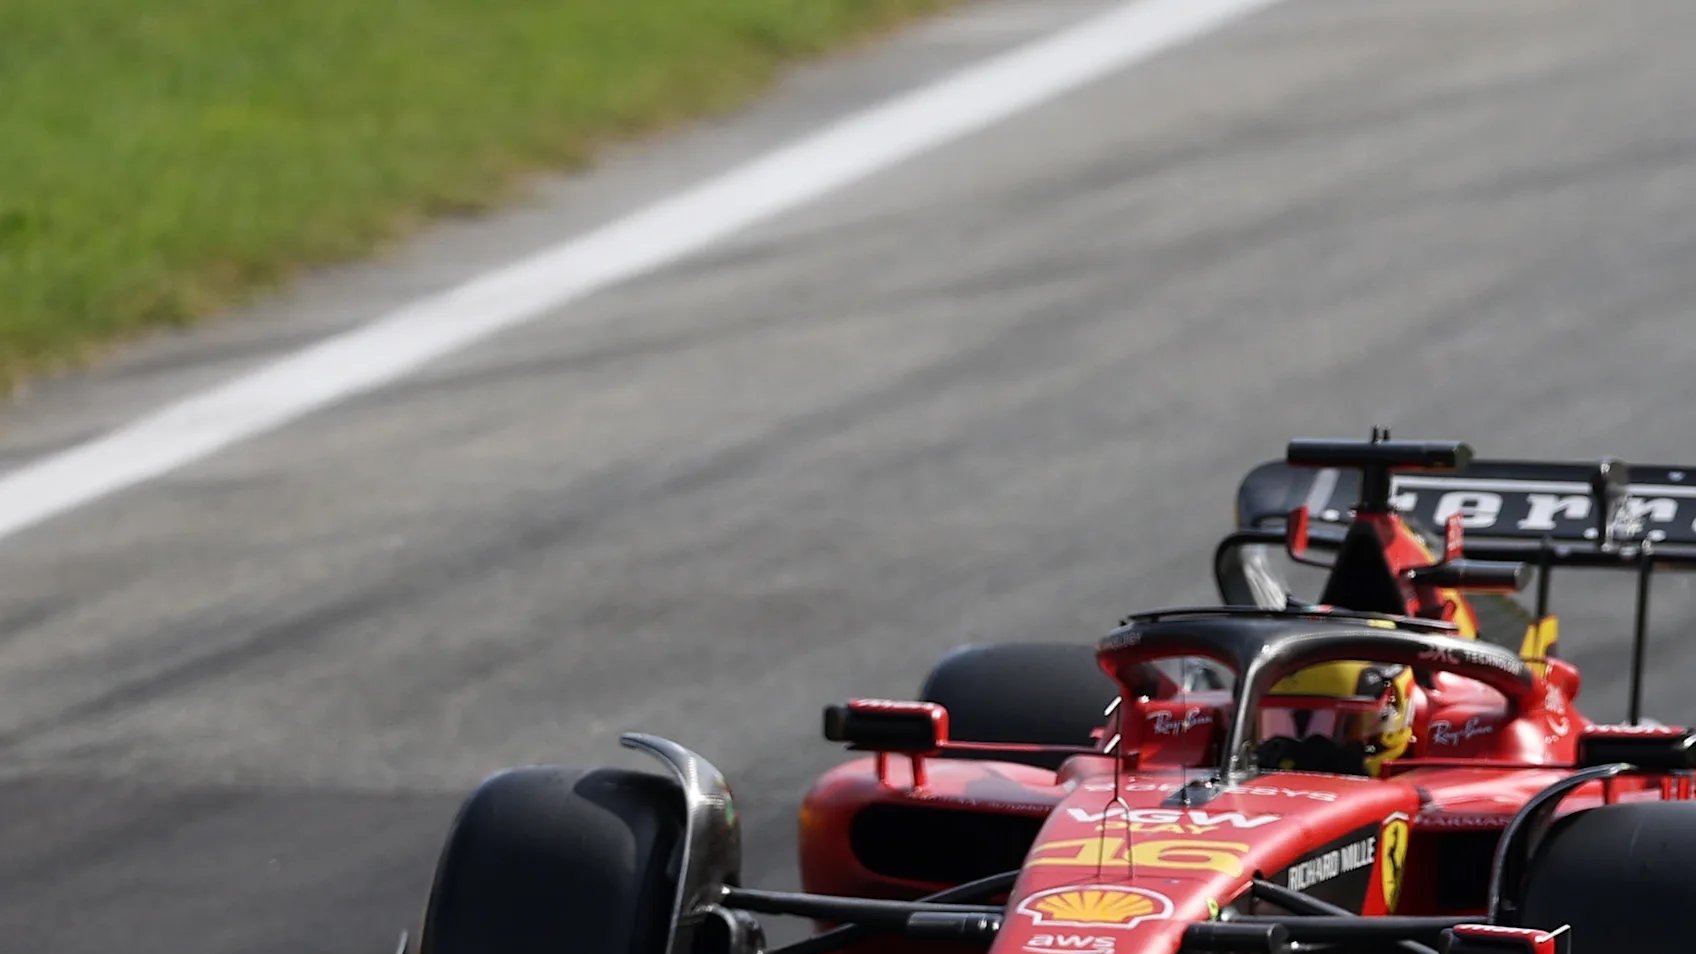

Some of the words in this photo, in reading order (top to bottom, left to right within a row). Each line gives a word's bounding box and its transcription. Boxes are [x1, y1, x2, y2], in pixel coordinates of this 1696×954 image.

[1066, 807, 1282, 829] VGW
[1095, 821, 1221, 835] PLAY
[1025, 837, 1250, 878] 16
[1288, 850, 1340, 892] RICHARD
[1341, 836, 1377, 872] MILLE
[1027, 933, 1117, 949] aws
